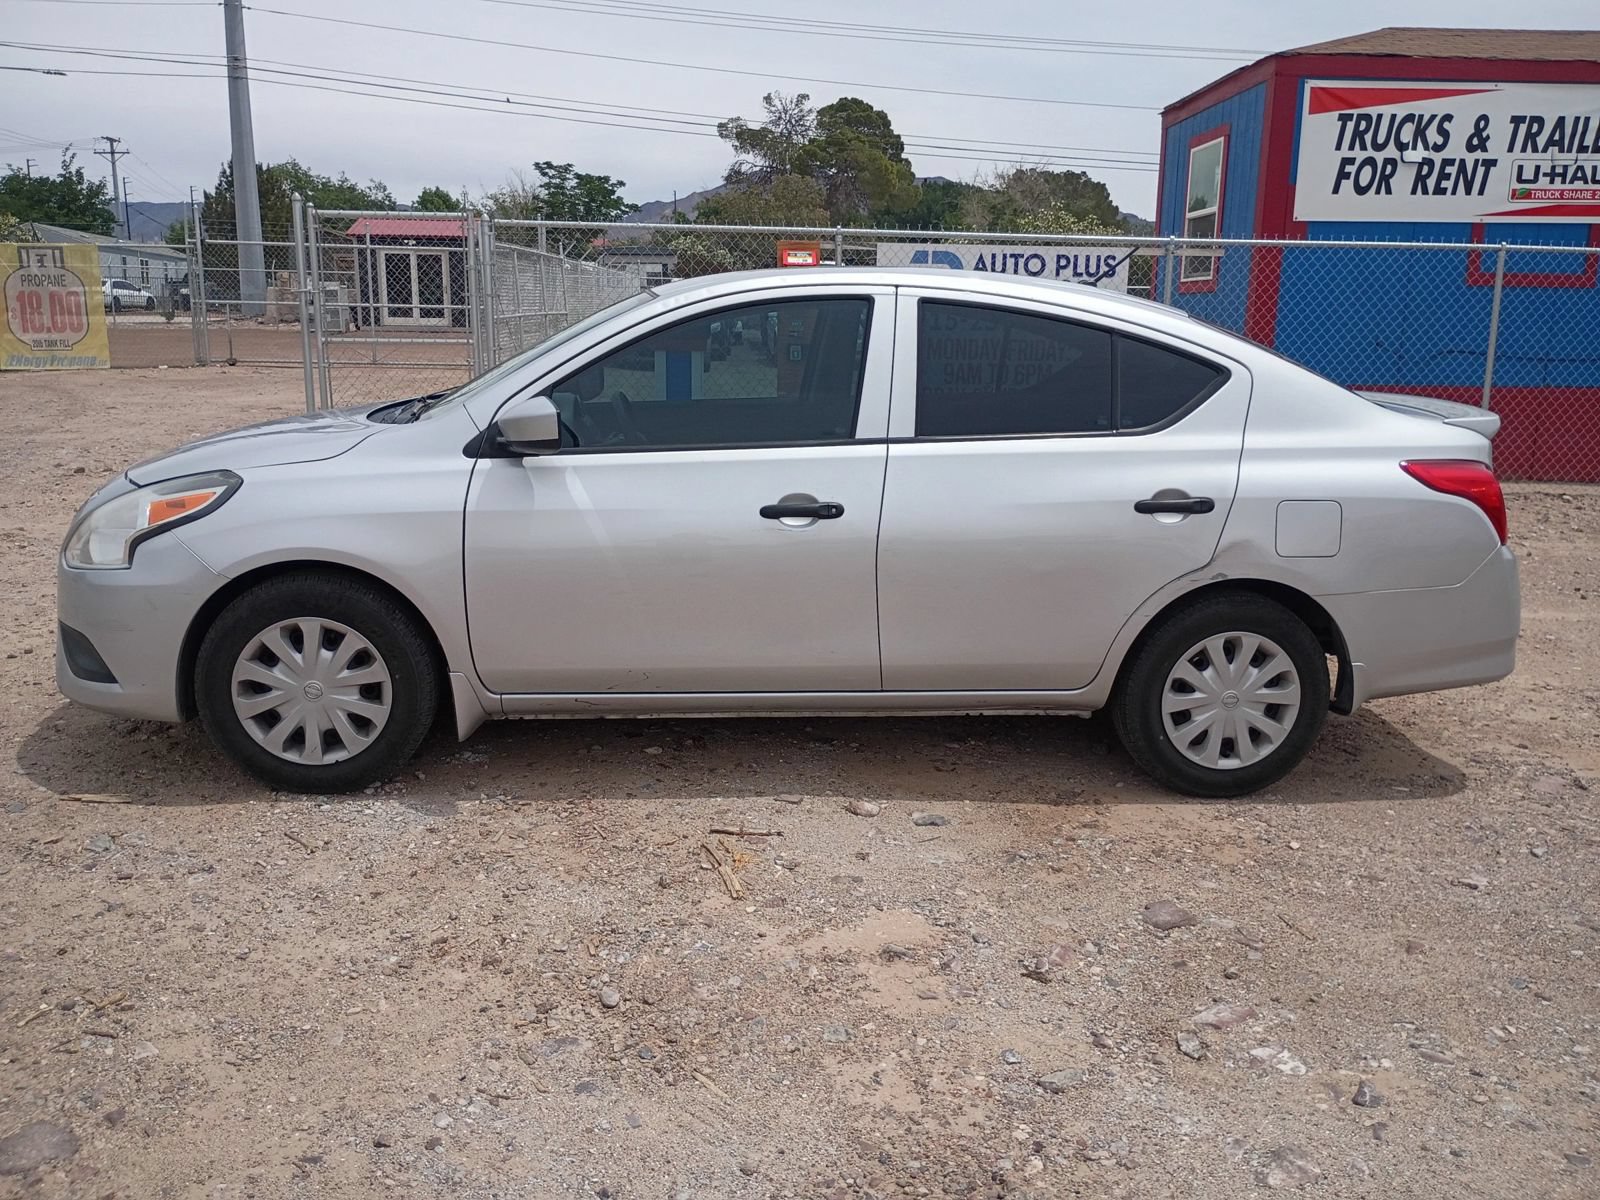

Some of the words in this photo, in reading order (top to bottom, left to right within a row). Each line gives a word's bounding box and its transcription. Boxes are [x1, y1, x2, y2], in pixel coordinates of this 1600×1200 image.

[1334, 113, 1454, 153] TRUCKS
[1465, 113, 1491, 153] &
[1331, 156, 1398, 195] FOR
[1410, 158, 1498, 196] RENT
[1531, 190, 1561, 199] TRUCK
[1563, 190, 1593, 199] SHARE
[973, 252, 1046, 277] AUTO
[1055, 254, 1117, 278] PLUS
[20, 274, 67, 287] PROPANE
[44, 339, 58, 348] TANK
[60, 339, 71, 348] FILL
[926, 337, 1001, 361] MONDAY
[944, 363, 983, 386] 9AM
